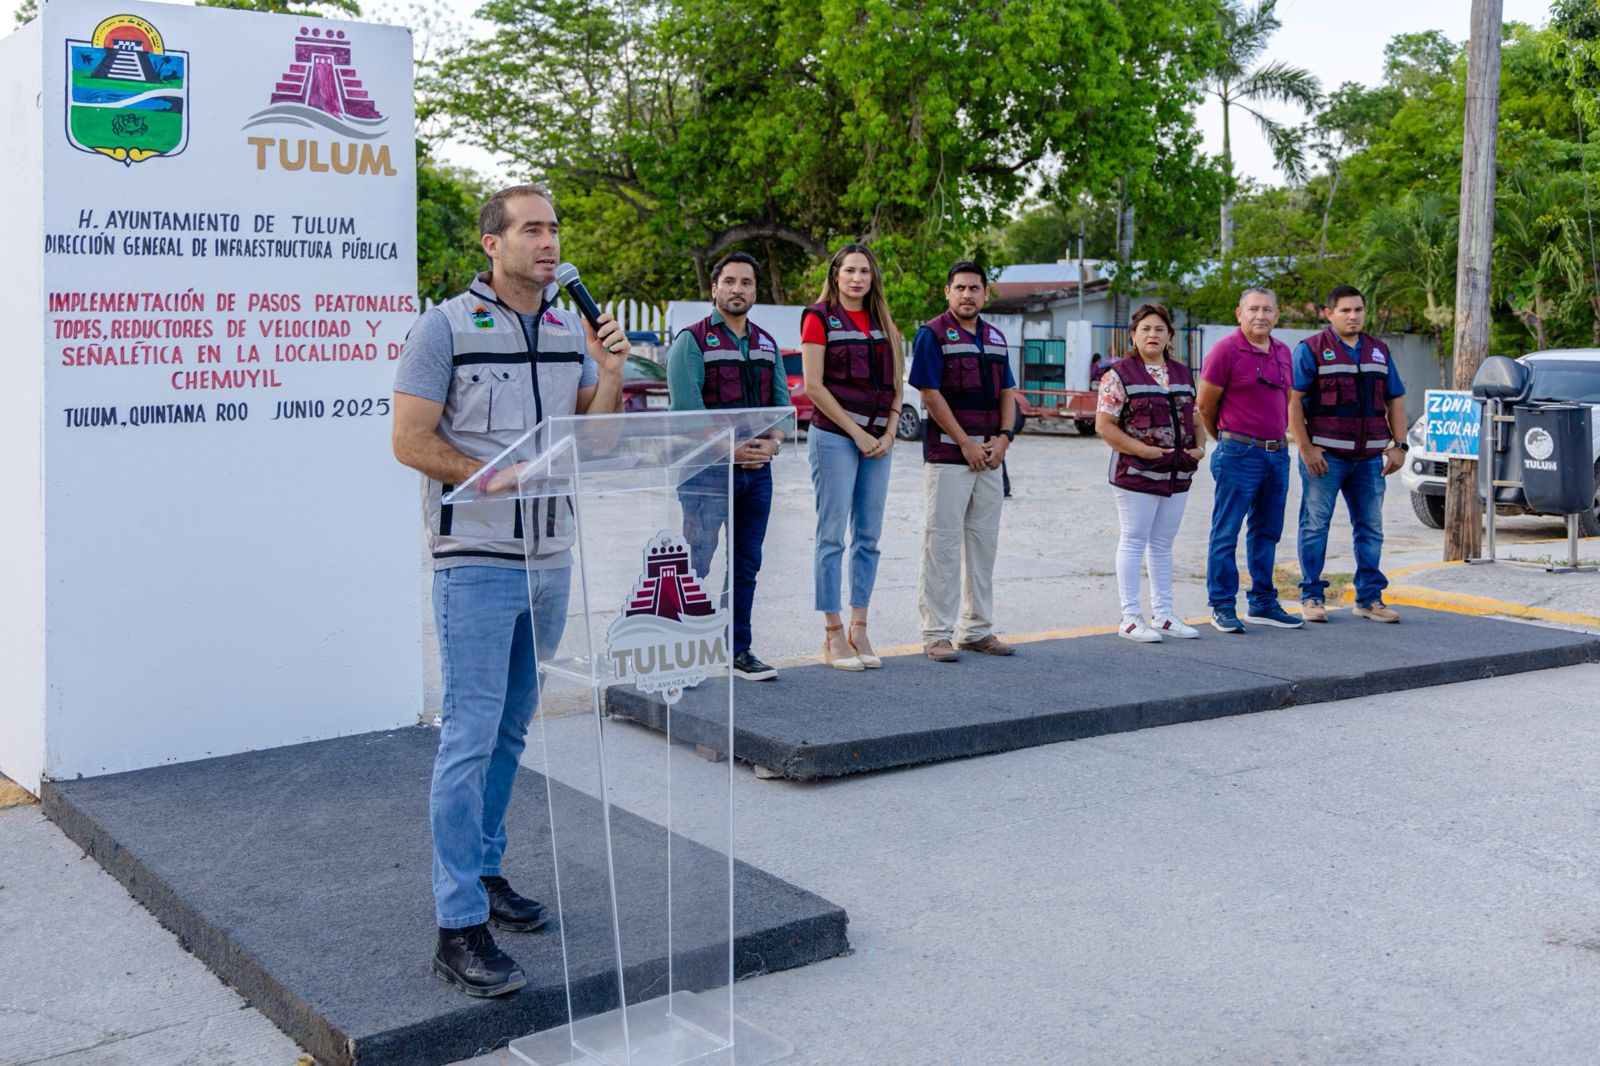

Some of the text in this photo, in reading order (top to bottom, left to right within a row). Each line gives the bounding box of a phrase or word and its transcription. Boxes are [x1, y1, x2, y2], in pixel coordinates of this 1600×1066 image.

[248, 136, 397, 176] TULUM
[79, 209, 355, 234] H. AYUNTAMIENTO DE TULUM
[45, 232, 397, 260] DIRECCIÓN GENERAL DE INFRAESTRUCTURA PÚBLICA
[50, 288, 204, 312] IMPLEMENTACIÓN
[217, 293, 235, 311] DE
[249, 294, 301, 312] PASOS
[227, 320, 246, 337] DE
[259, 320, 350, 338] VELOCIDAD
[366, 320, 381, 337] Y
[62, 341, 183, 366] SEÑALÉTICA
[198, 345, 220, 363] EN
[238, 345, 260, 362] LA
[276, 344, 377, 362] LOCALIDAD
[172, 369, 282, 390] CHEMUYIL
[216, 402, 248, 421] ROO
[272, 400, 324, 420] JUNIO
[332, 398, 390, 417] 2025
[1429, 397, 1472, 413] ZONA
[1426, 420, 1480, 437] ESCOLAR
[1524, 459, 1557, 471] TULUM
[612, 637, 727, 678] TULUM
